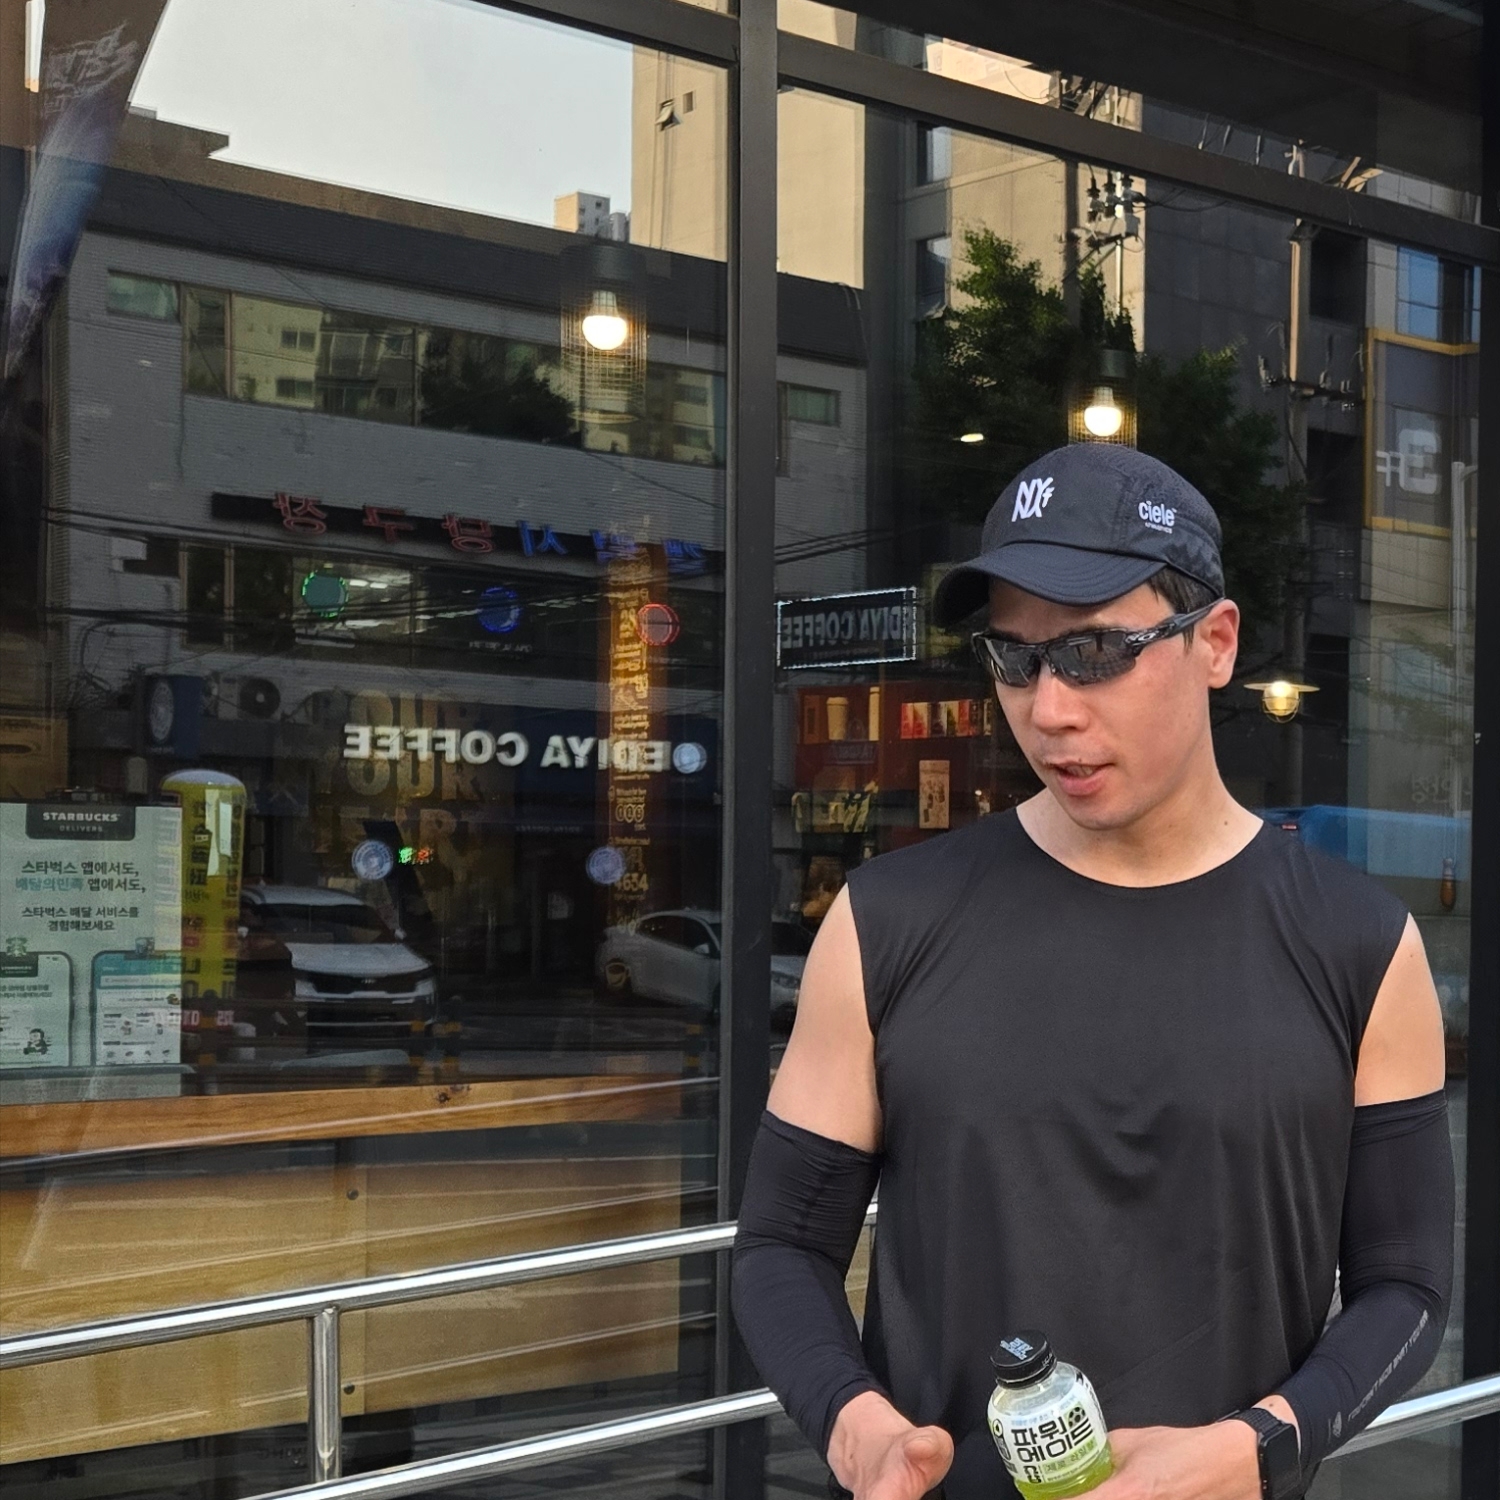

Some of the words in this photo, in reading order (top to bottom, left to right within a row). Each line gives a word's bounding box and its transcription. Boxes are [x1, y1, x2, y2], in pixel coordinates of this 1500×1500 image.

[43, 812, 119, 822] STARBUCKS
[59, 825, 103, 833] DELIVERS
[21, 861, 78, 875] 스타벅스
[81, 861, 139, 876] 앱에서도,
[15, 878, 84, 891] 배달의민족
[87, 878, 146, 893] 앱에서도,
[21, 907, 67, 918] 스타벅스
[69, 907, 92, 917] 배달
[95, 907, 139, 918] 서비스를
[48, 921, 115, 932] 경험해보세요
[1011, 1416, 1069, 1446] 파워
[1017, 1417, 1094, 1463] 에이드
